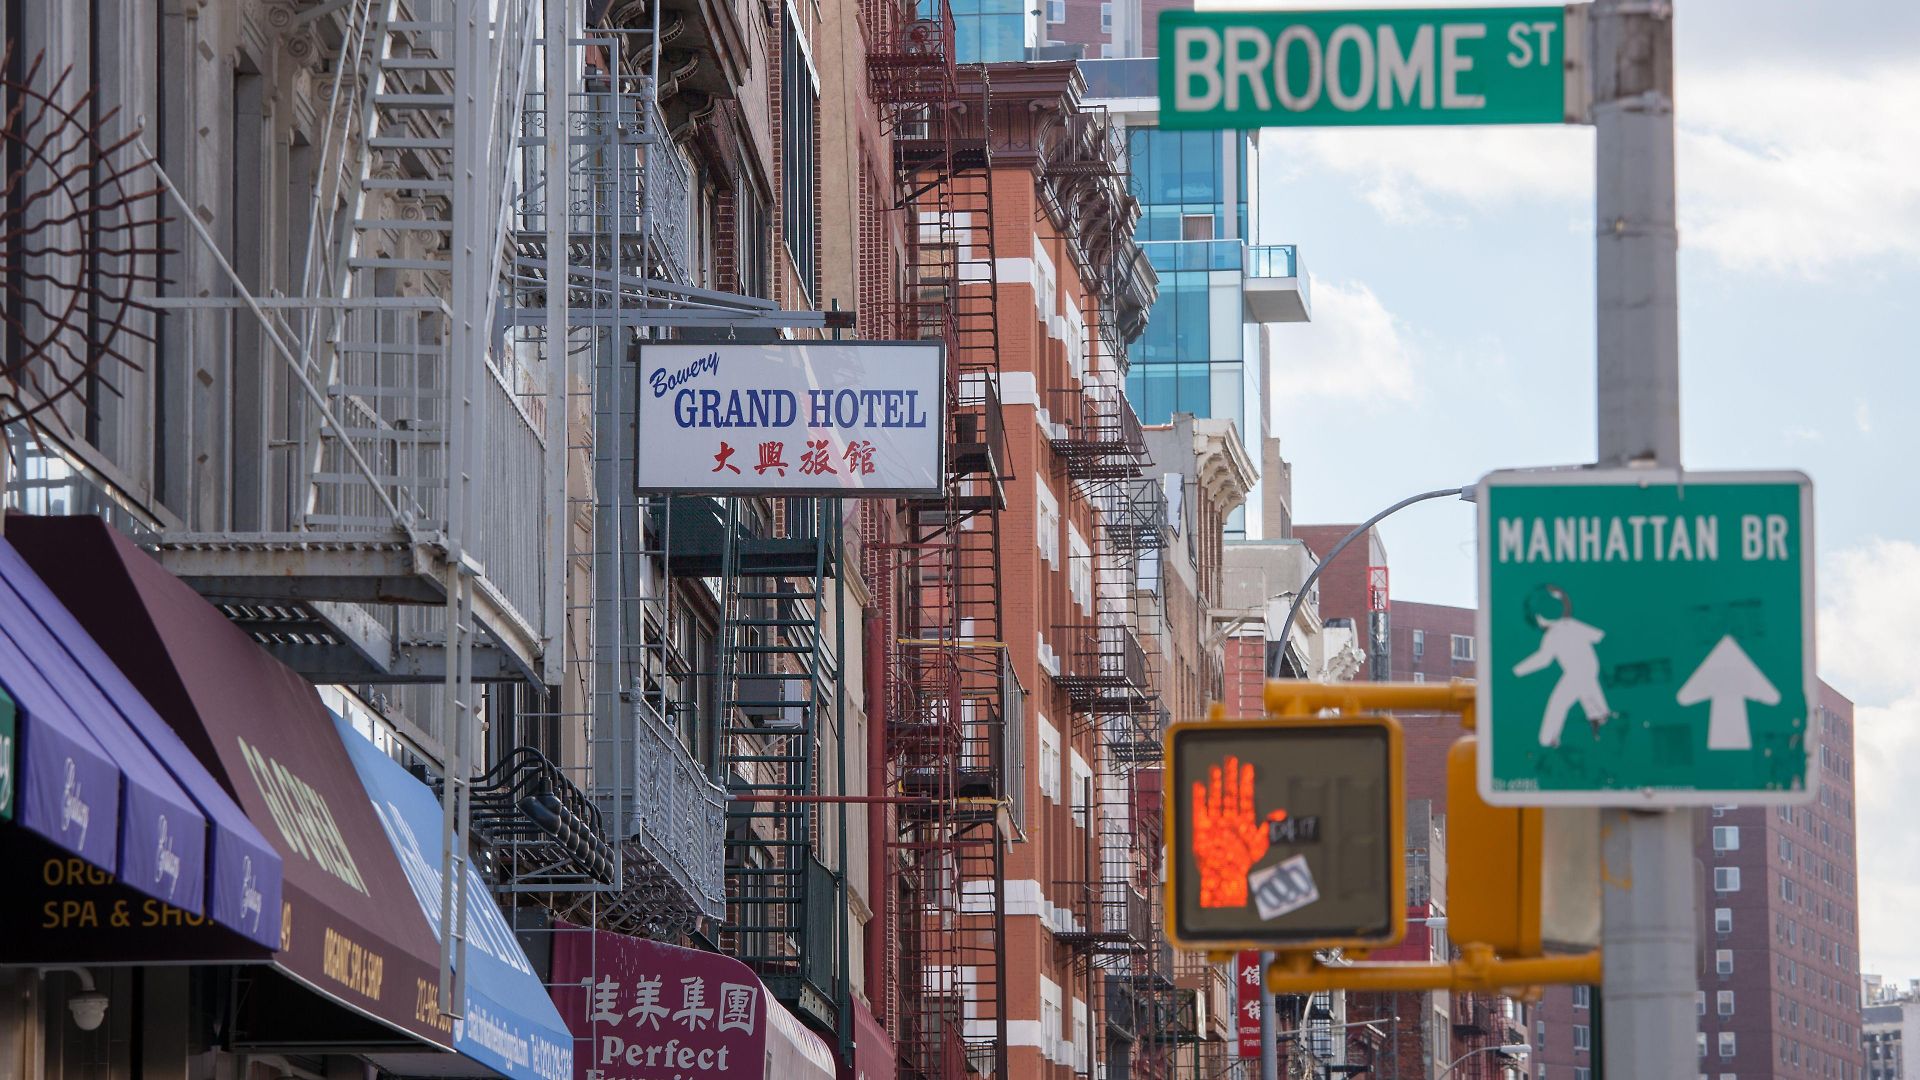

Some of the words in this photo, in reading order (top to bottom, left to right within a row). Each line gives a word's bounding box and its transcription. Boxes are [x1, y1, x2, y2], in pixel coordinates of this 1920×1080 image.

[1174, 24, 1487, 112] BROOME
[1506, 22, 1556, 68] ST
[649, 352, 720, 398] Bowery
[674, 388, 797, 428] GRAND
[808, 388, 927, 428] HOTEL
[711, 440, 877, 478] 大興旅館
[1498, 515, 1719, 563] MANHATTAN
[1741, 514, 1789, 561] BR
[43, 900, 98, 928] SPA
[110, 899, 130, 927] &
[142, 899, 215, 927] SHO
[580, 974, 759, 1037] 佳美集團
[601, 1035, 729, 1071] Perfect
